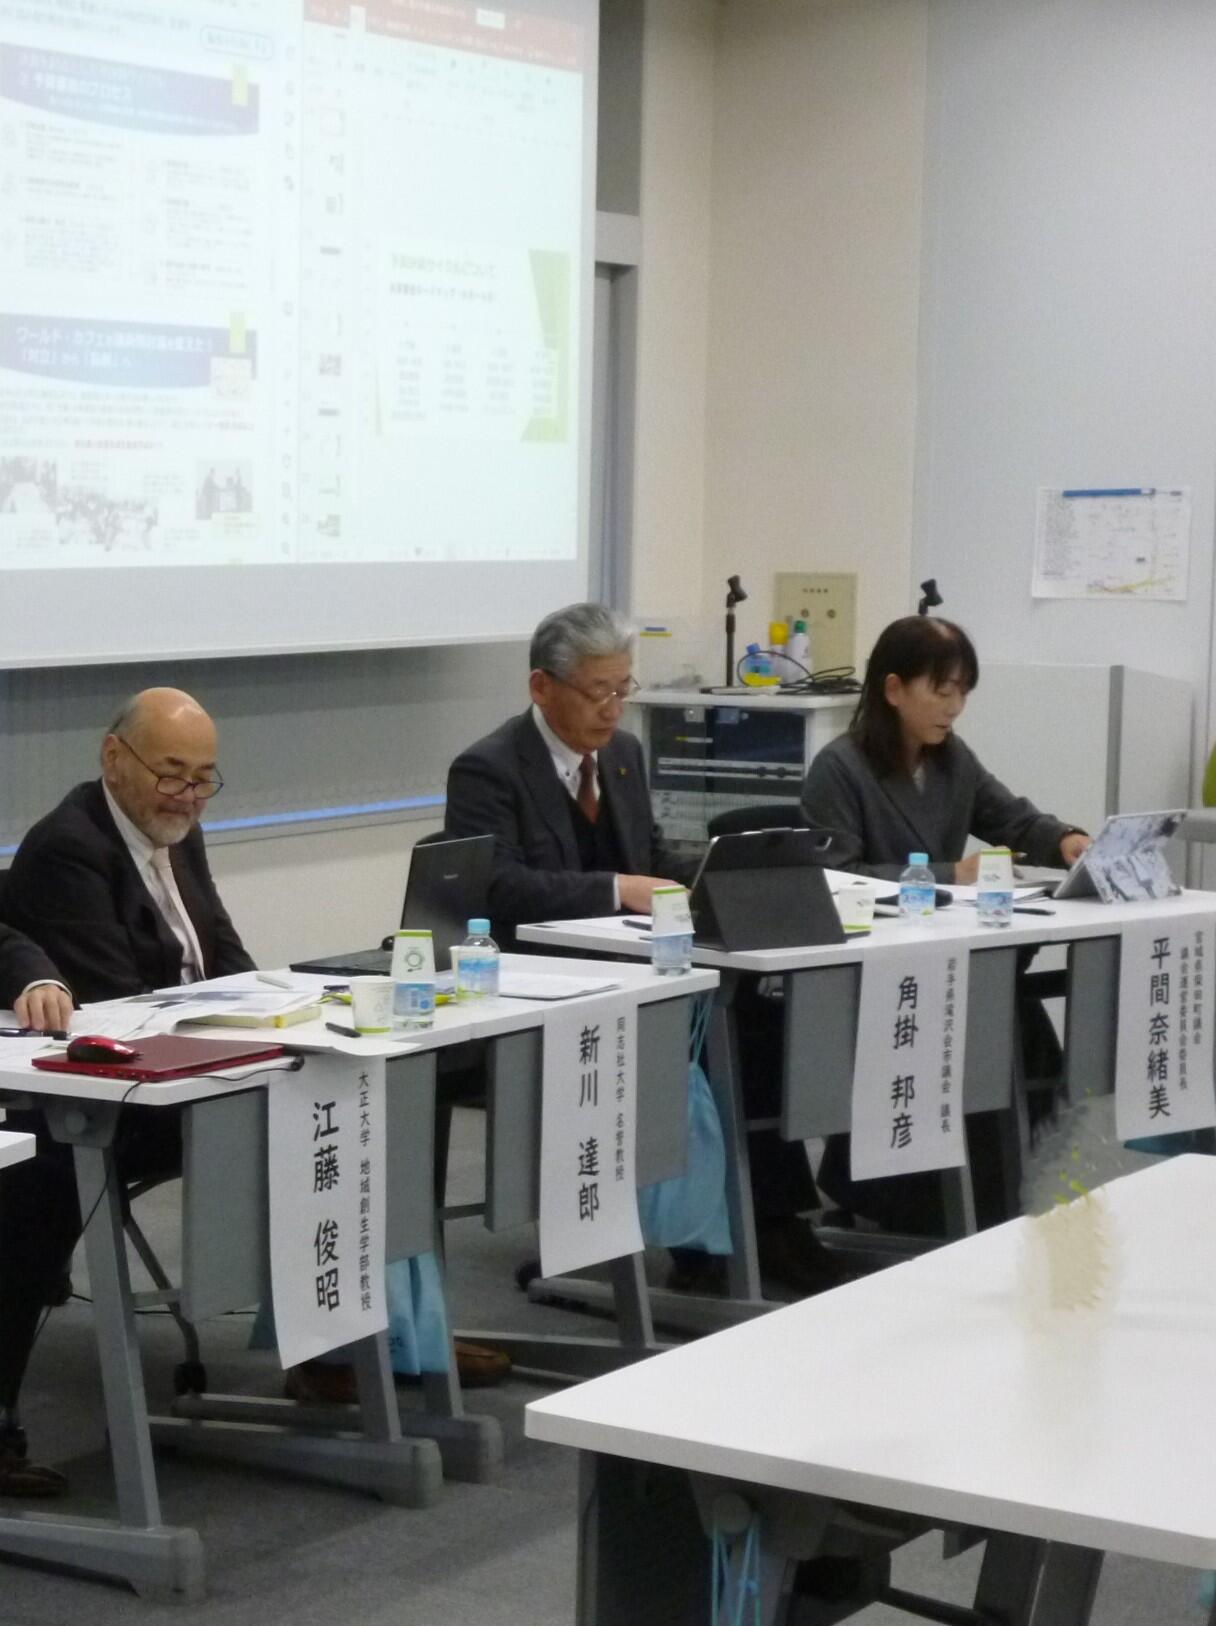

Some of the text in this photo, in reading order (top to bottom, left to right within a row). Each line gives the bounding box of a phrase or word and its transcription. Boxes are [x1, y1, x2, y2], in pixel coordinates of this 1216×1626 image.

[358, 1071, 370, 1148] 大正大学
[890, 975, 920, 1150] 角掛 邦彦
[1147, 936, 1171, 1119] 平間奈緒美
[313, 1100, 341, 1313] 江藤 俊昭
[577, 1024, 601, 1222] 新川 達郎
